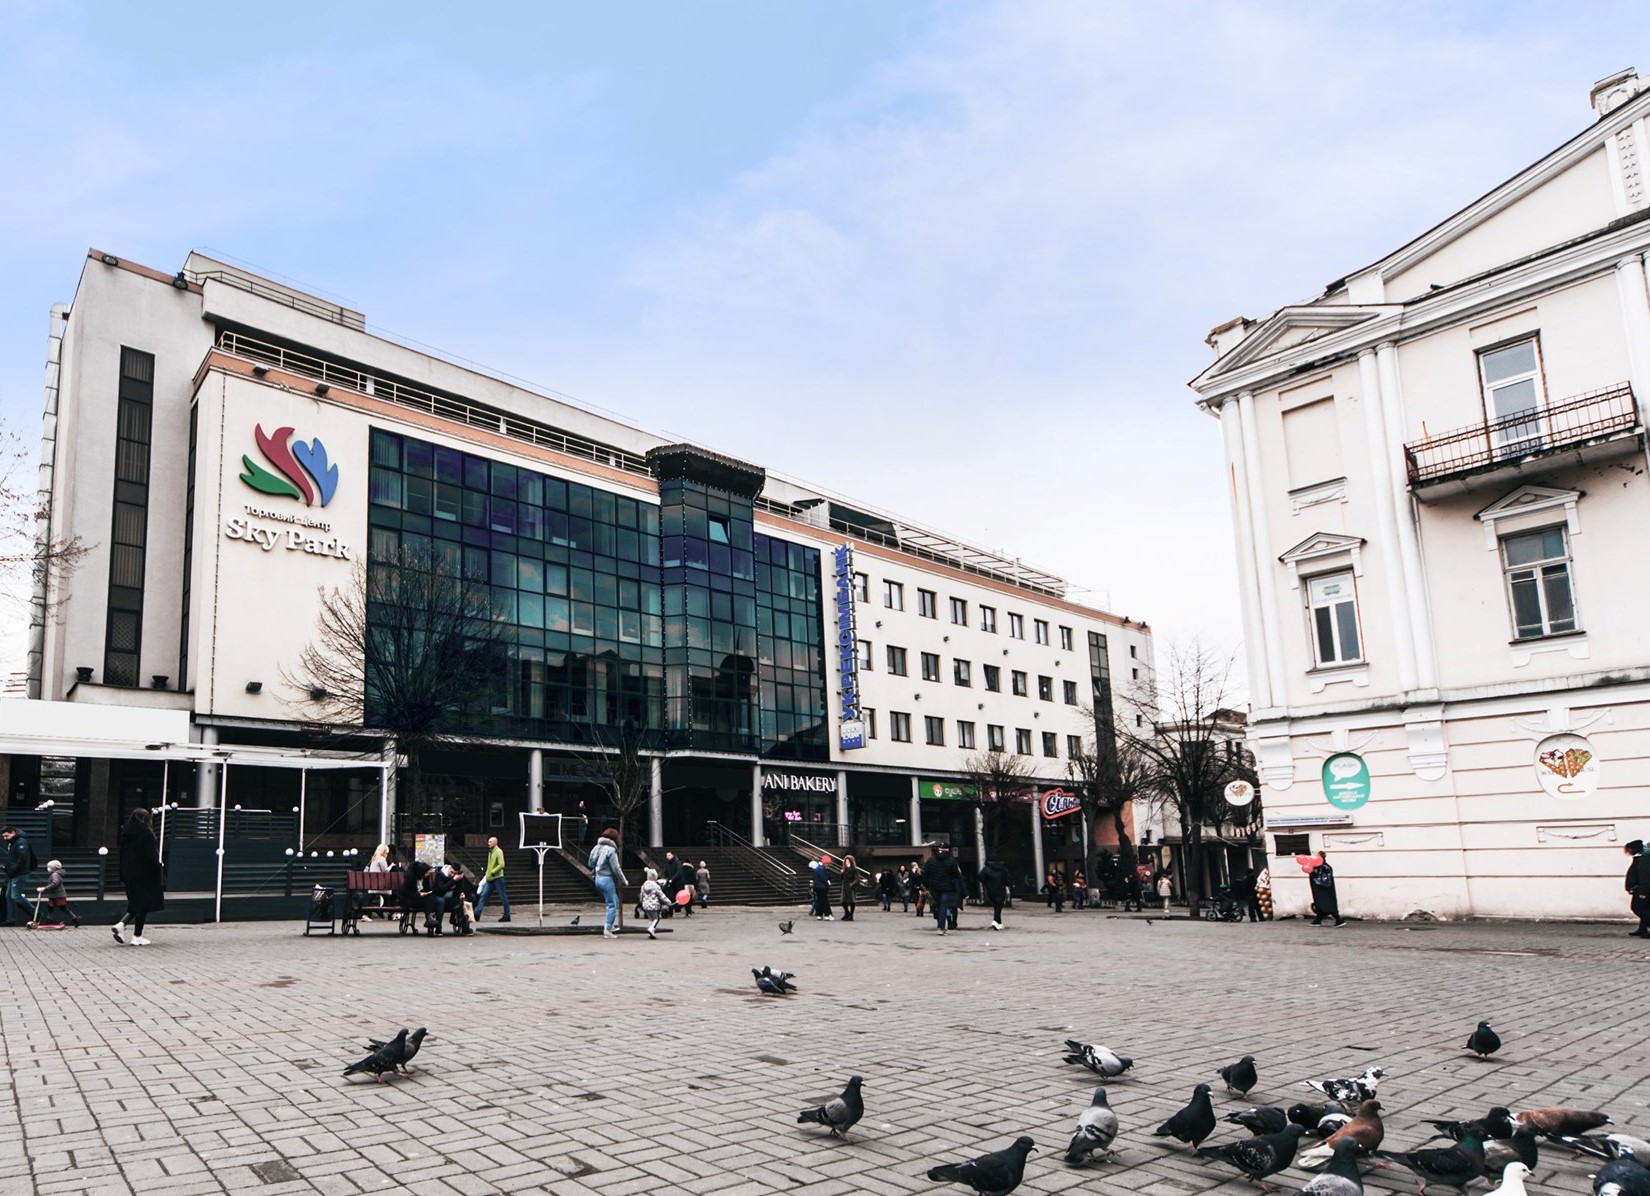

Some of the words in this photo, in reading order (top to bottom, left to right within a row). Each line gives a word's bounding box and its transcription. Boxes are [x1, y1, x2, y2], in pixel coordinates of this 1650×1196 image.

[225, 518, 281, 551] Sky
[286, 528, 351, 560] Park
[834, 542, 856, 721] УКРЕКСІМБАНК
[764, 773, 788, 790] ANI
[790, 774, 836, 793] BAKERY
